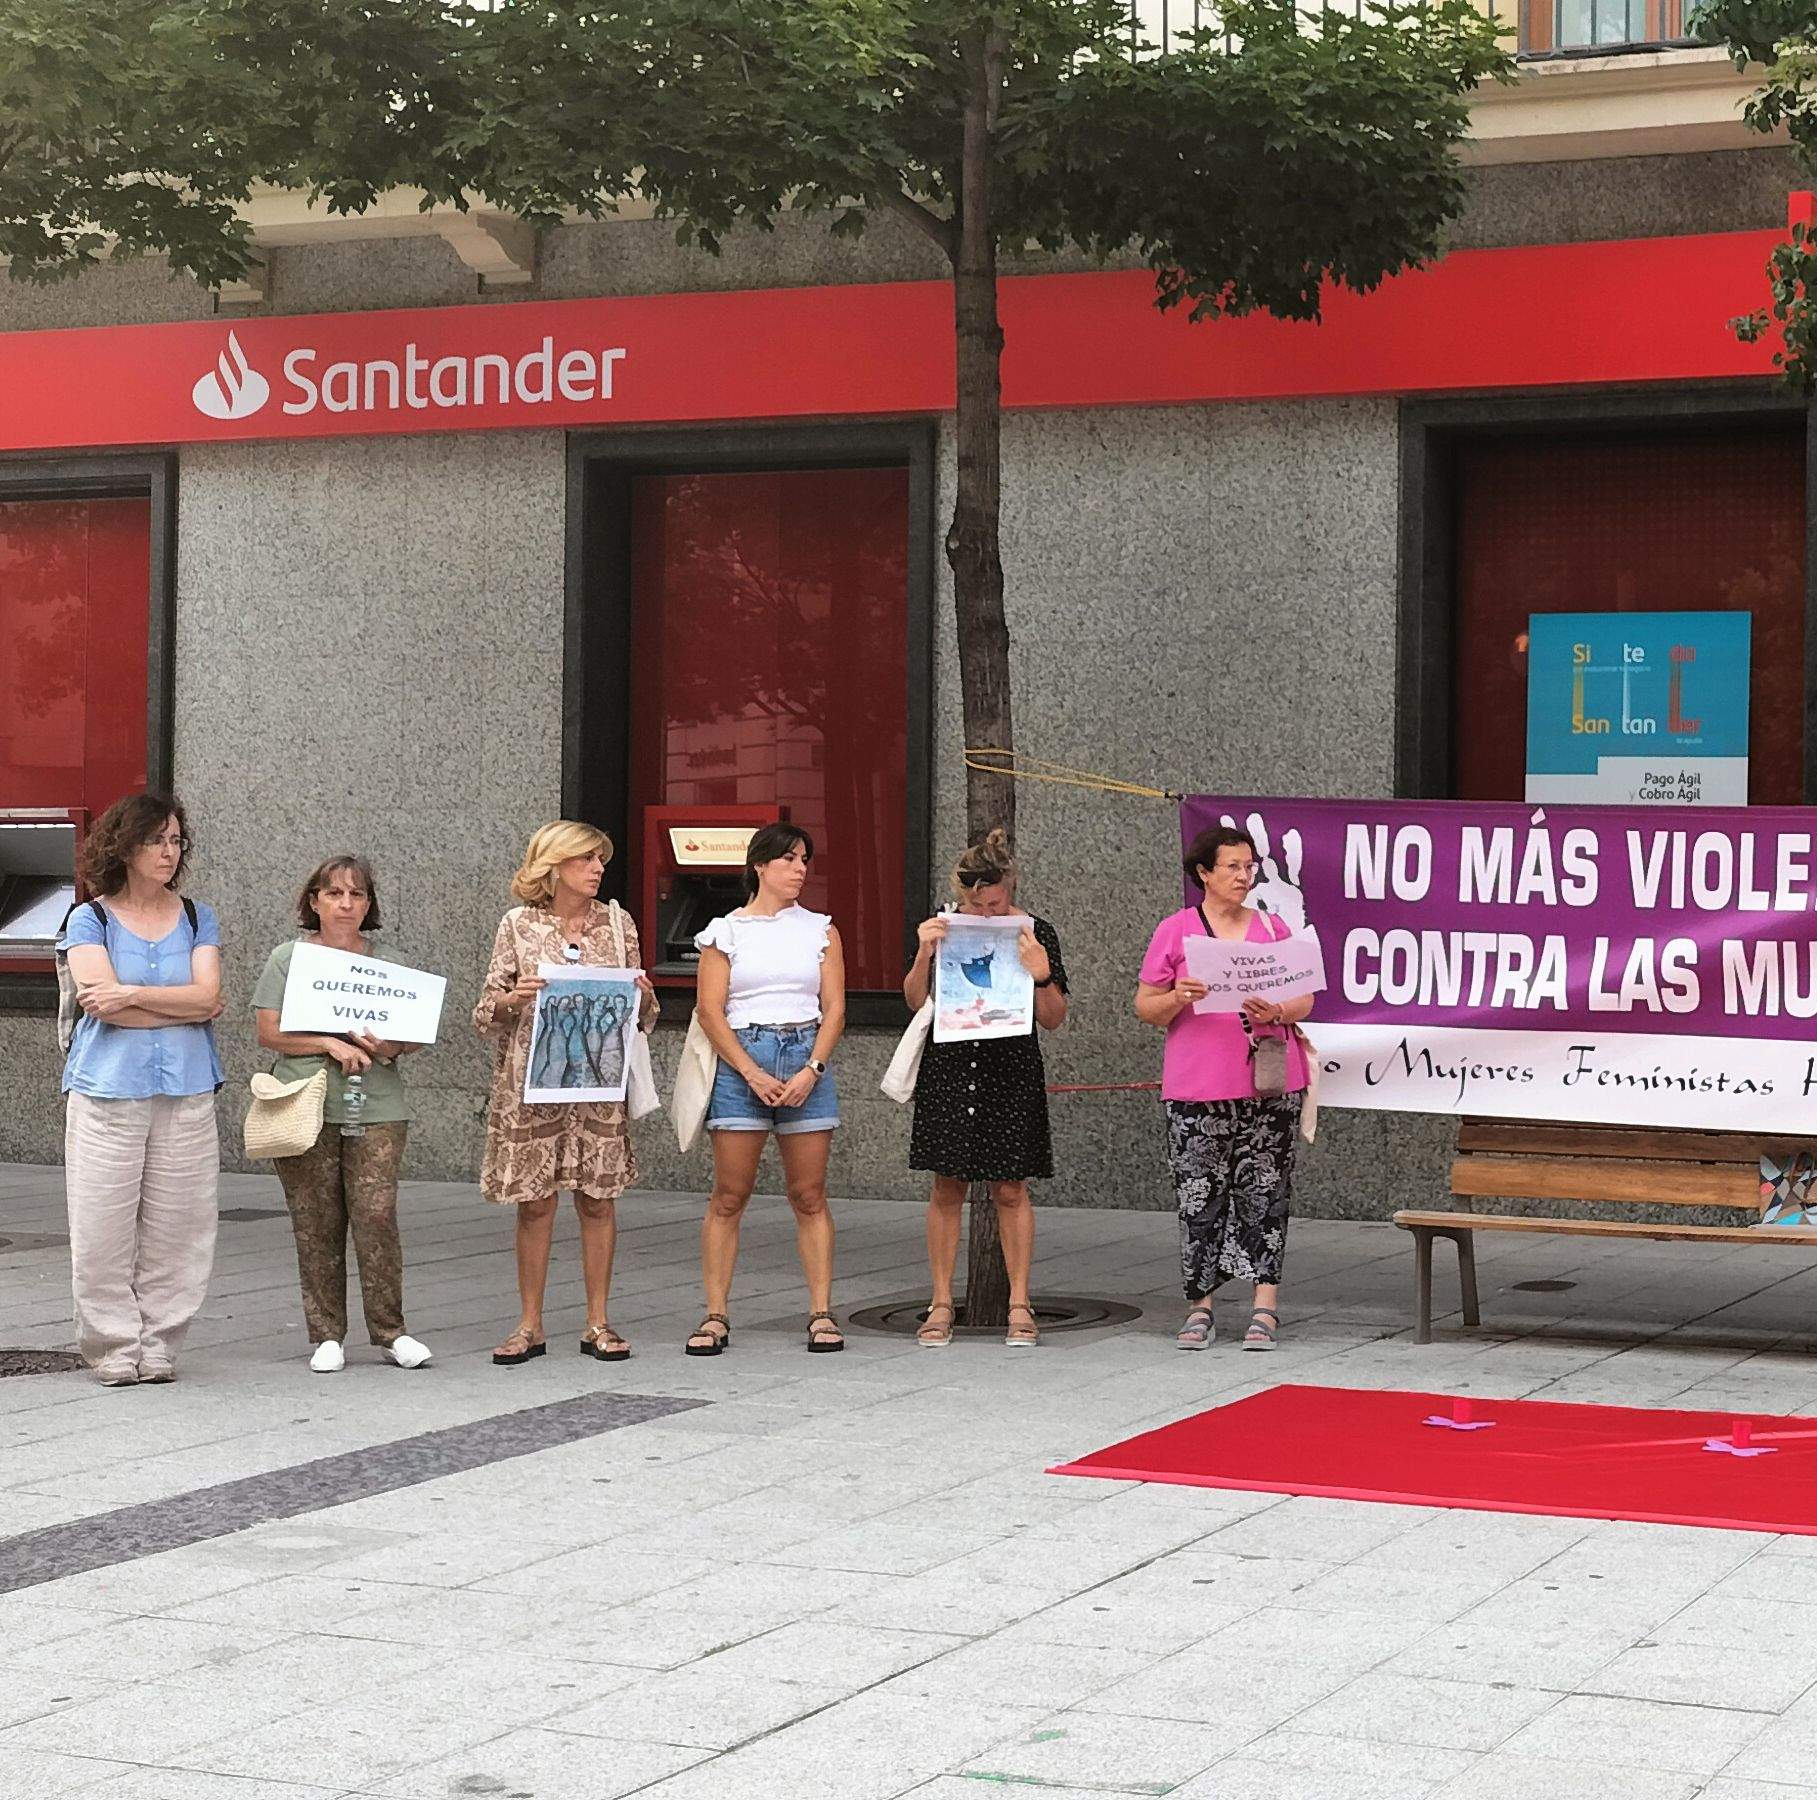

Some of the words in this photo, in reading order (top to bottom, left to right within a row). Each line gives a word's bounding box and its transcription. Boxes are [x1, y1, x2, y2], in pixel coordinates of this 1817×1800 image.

[282, 336, 626, 416] Santander
[1573, 643, 1592, 663] Si
[1623, 642, 1645, 663] te
[1572, 714, 1610, 734] San
[1622, 714, 1656, 734] tan
[1644, 772, 1674, 788] Pago
[1677, 770, 1701, 788] Ágil
[1639, 787, 1674, 800] Cobro
[1677, 786, 1701, 802] Ágil
[701, 840, 746, 852] Santand
[1344, 822, 1432, 901] NO
[1459, 808, 1599, 908] MÁS
[1230, 954, 1276, 966] VIVAS
[350, 965, 388, 979] NOS
[1222, 970, 1232, 979] Y
[1237, 965, 1288, 979] LIBRES
[1236, 969, 1314, 993] QUEREMOS
[1344, 927, 1568, 1012] CONTRA
[1588, 937, 1700, 1015] LAS
[312, 980, 417, 1000] QUEREMOS
[332, 1005, 389, 1022] VIVAS
[1365, 1036, 1534, 1107] Mujeres
[1562, 1045, 1774, 1096] Feministas
